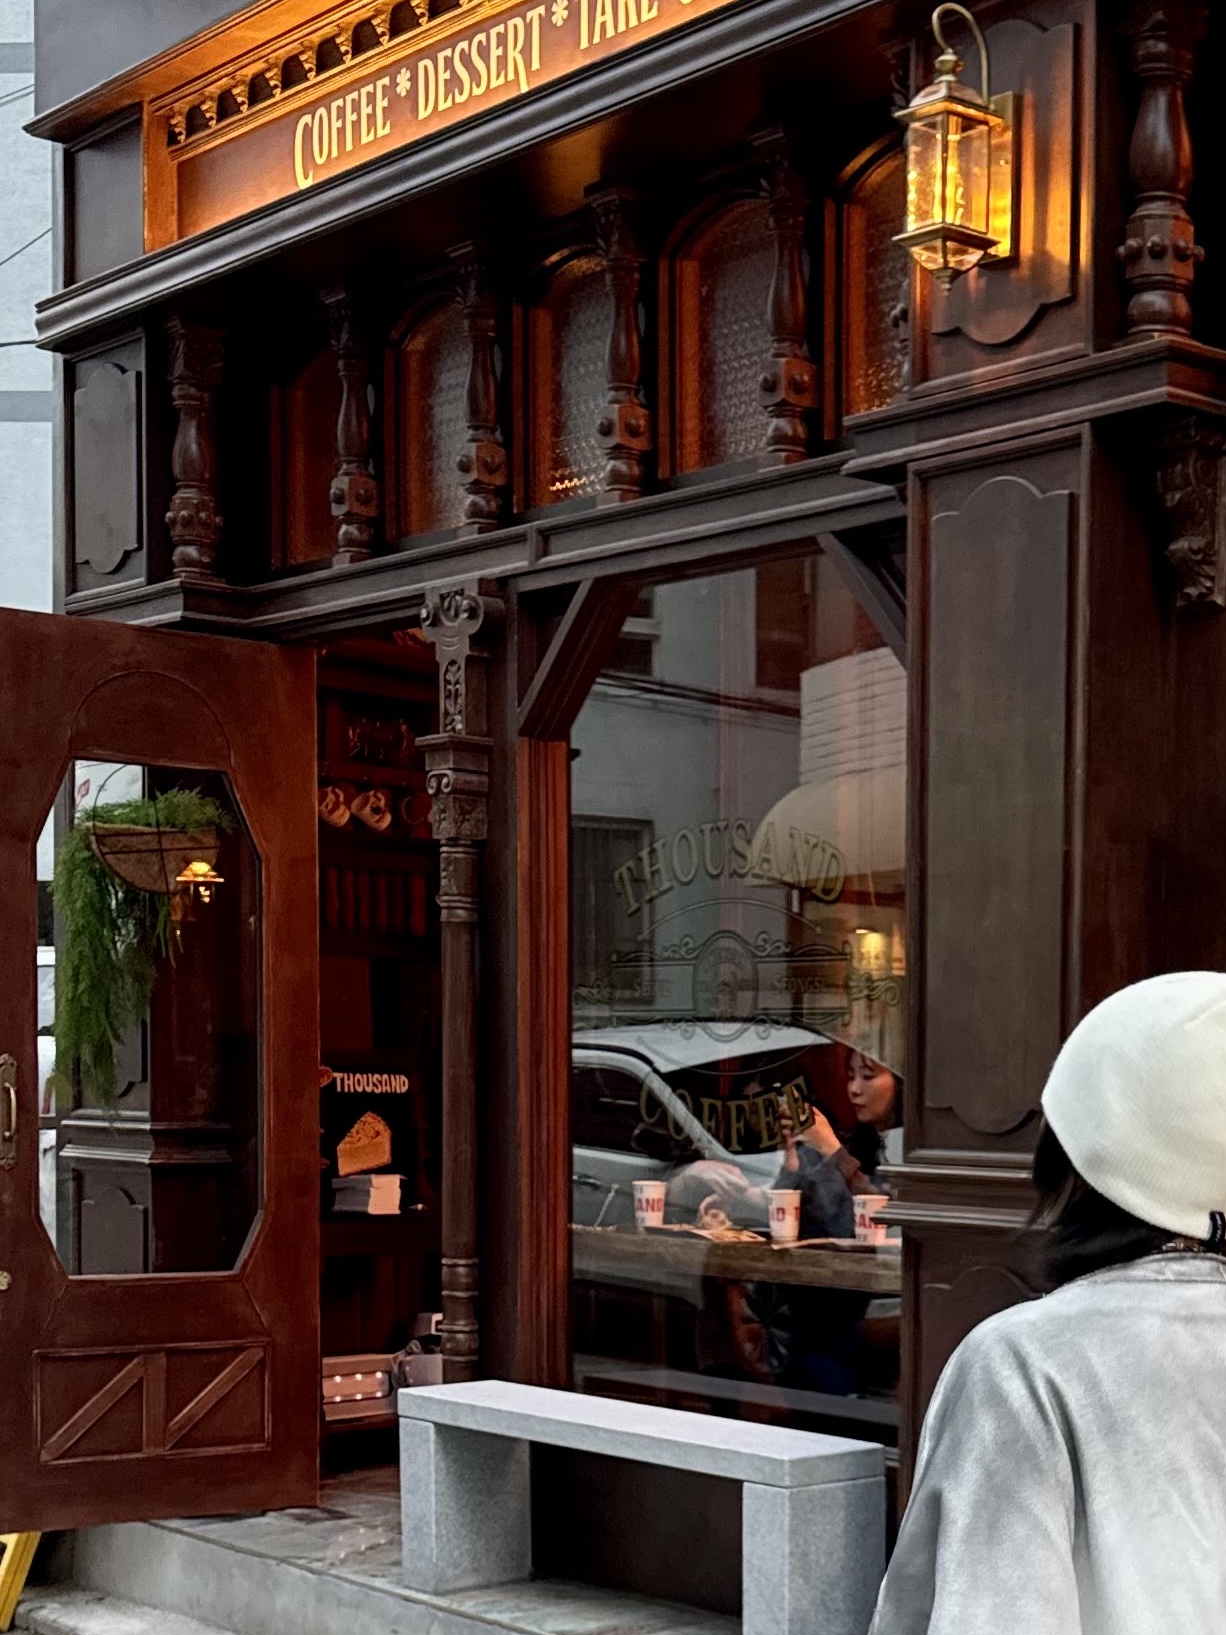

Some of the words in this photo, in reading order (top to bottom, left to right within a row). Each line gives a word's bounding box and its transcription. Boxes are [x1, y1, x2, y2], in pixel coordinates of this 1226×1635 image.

[294, 76, 391, 190] COFFEE
[417, 5, 546, 120] DESSERT
[613, 817, 845, 918] THOUSAND
[332, 1072, 409, 1094] THOUSAND
[639, 1075, 816, 1151] COFFEE
